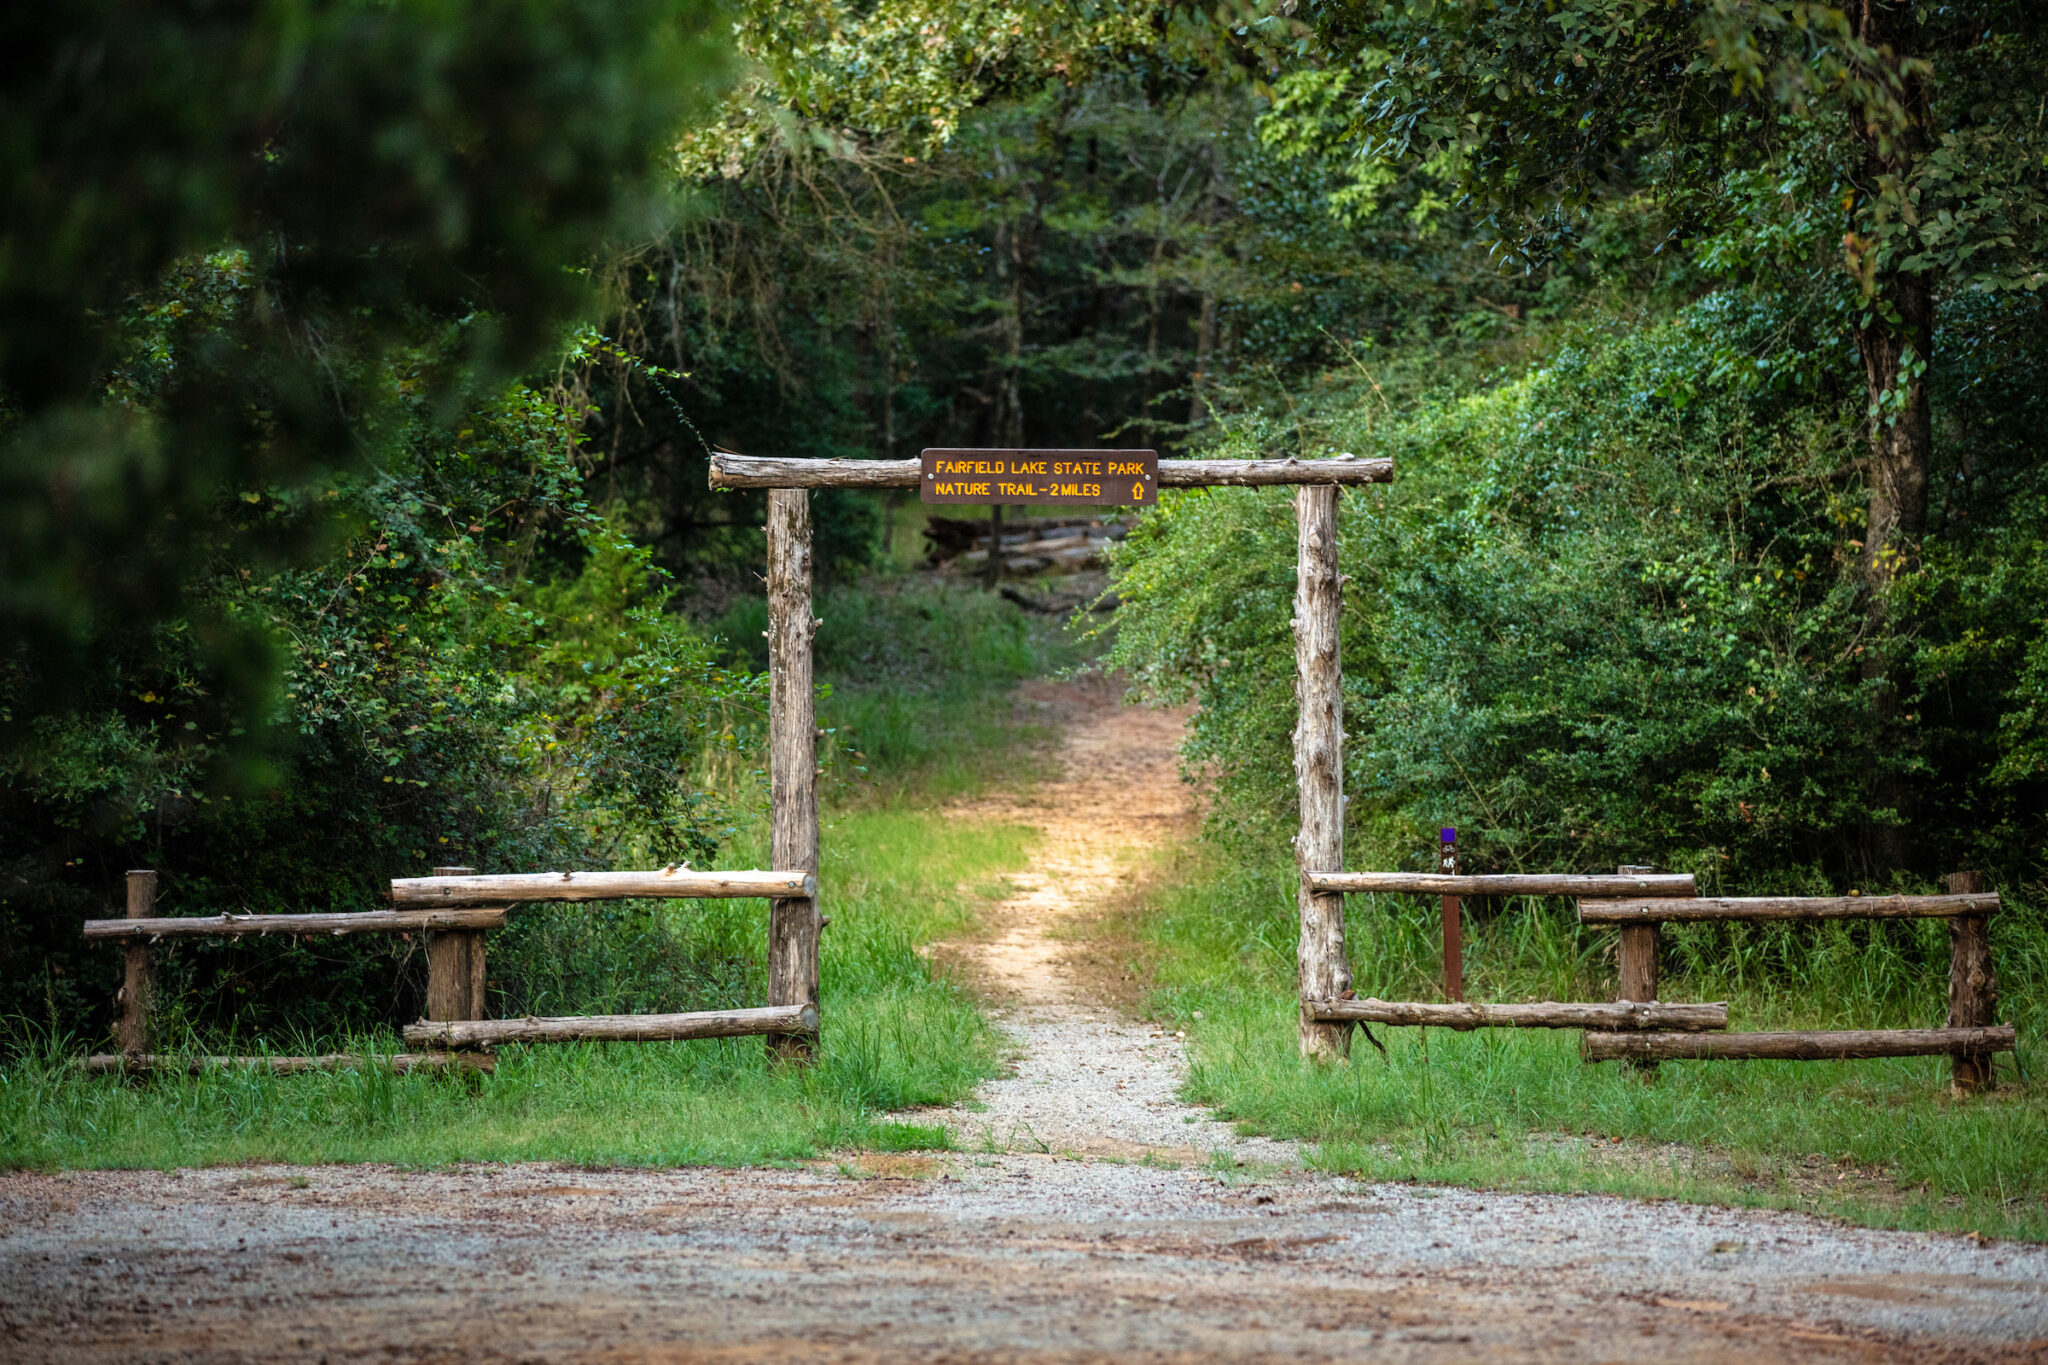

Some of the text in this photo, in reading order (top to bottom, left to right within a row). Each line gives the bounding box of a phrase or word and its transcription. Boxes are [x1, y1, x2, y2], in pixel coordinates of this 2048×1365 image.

[935, 460, 1145, 476] FAIRFIELD LAKE STATE PARK
[935, 482, 991, 496] NATURE
